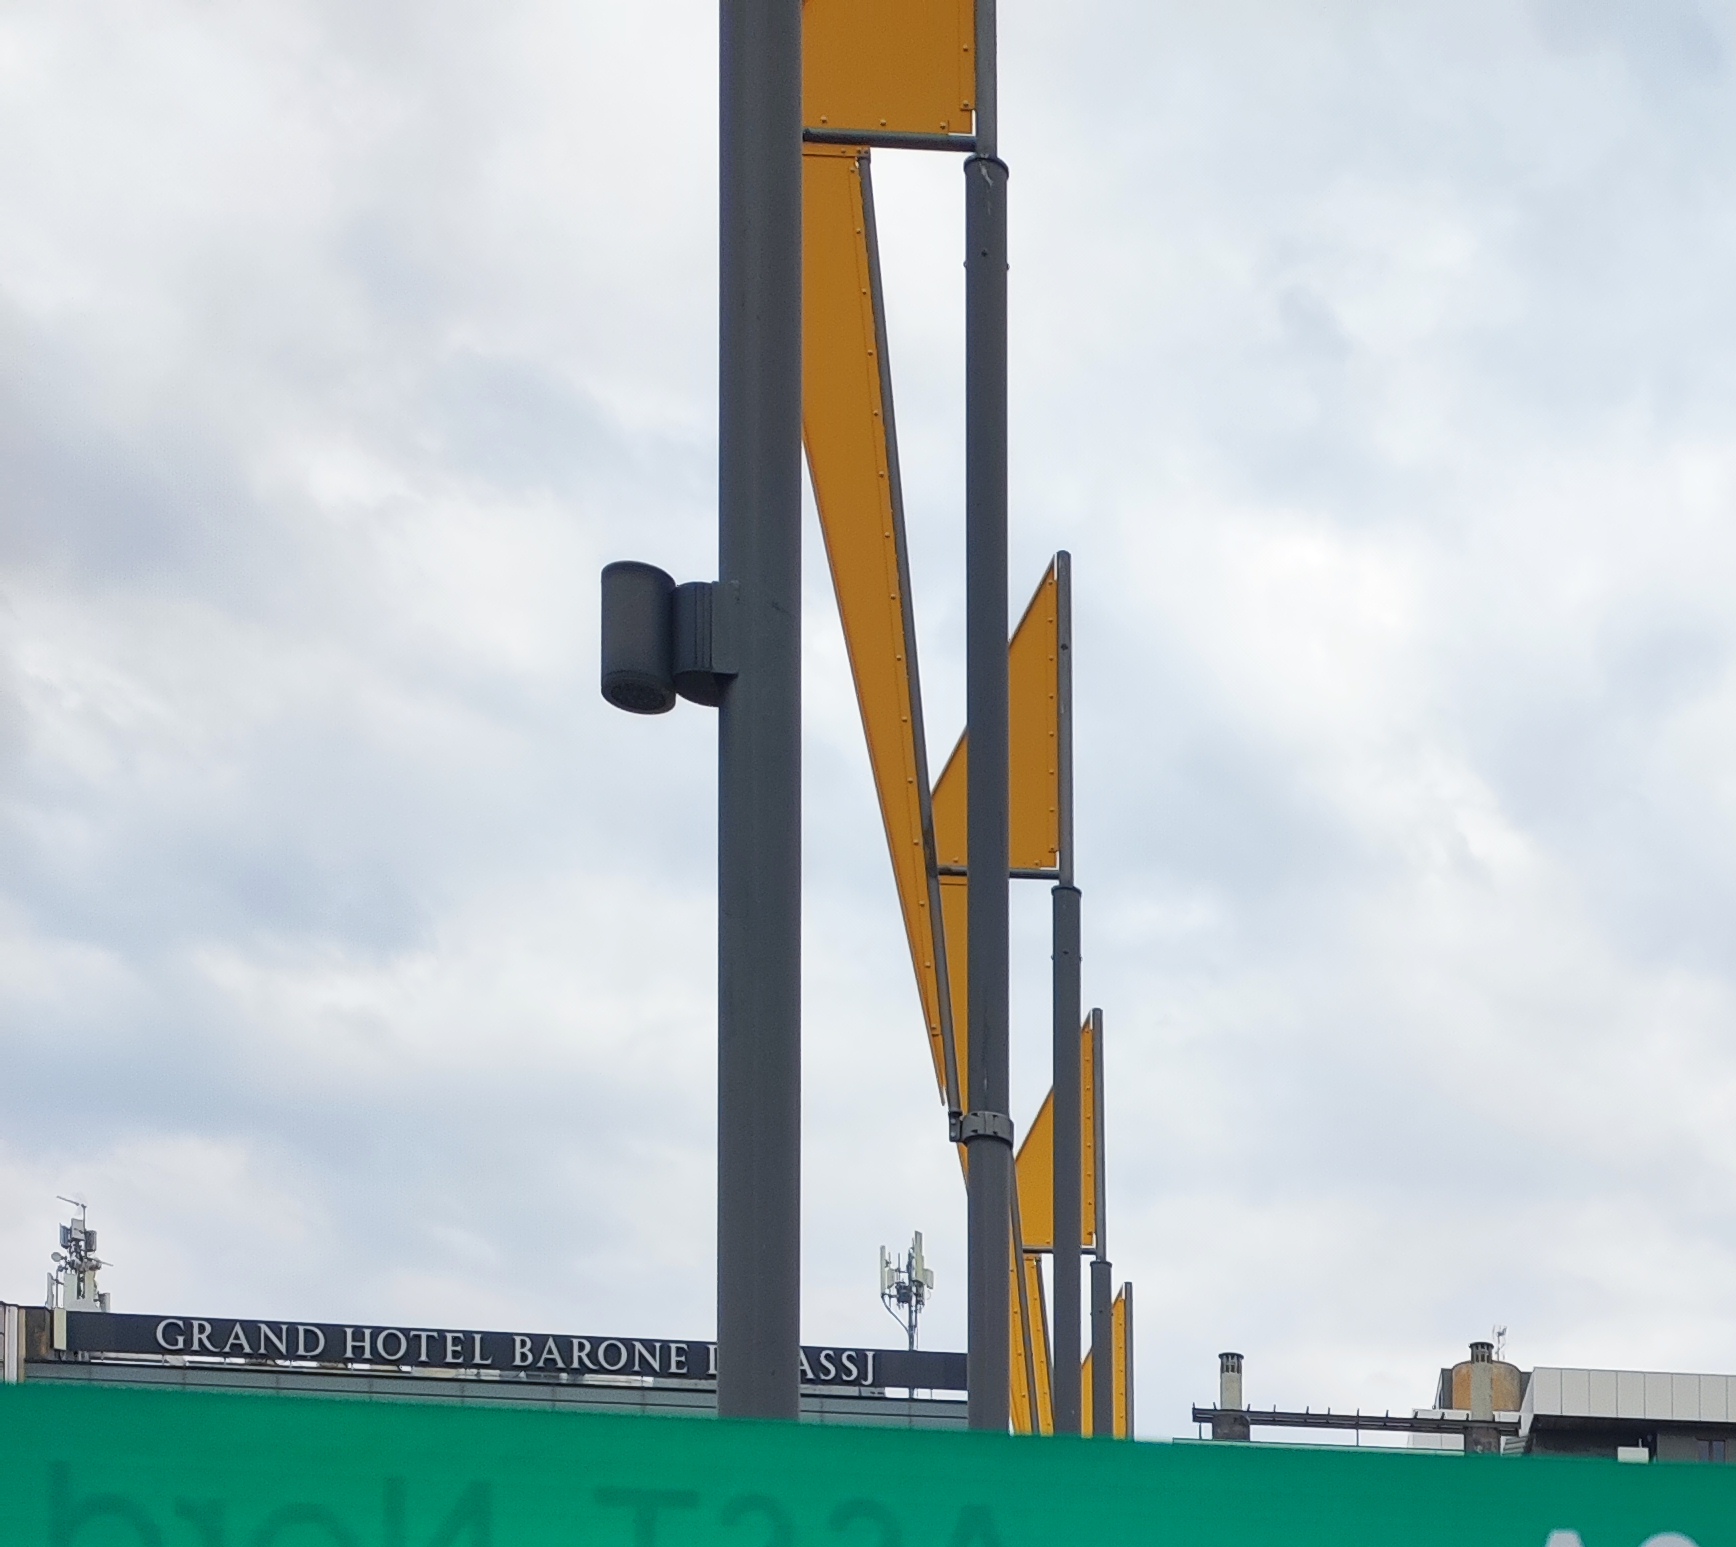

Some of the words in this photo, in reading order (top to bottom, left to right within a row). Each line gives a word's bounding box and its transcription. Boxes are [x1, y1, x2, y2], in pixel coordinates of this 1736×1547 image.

[155, 1318, 326, 1358] GRAND
[344, 1326, 493, 1367] HOTEL
[511, 1334, 689, 1375] BARONE
[799, 1348, 876, 1386] ASSJ
